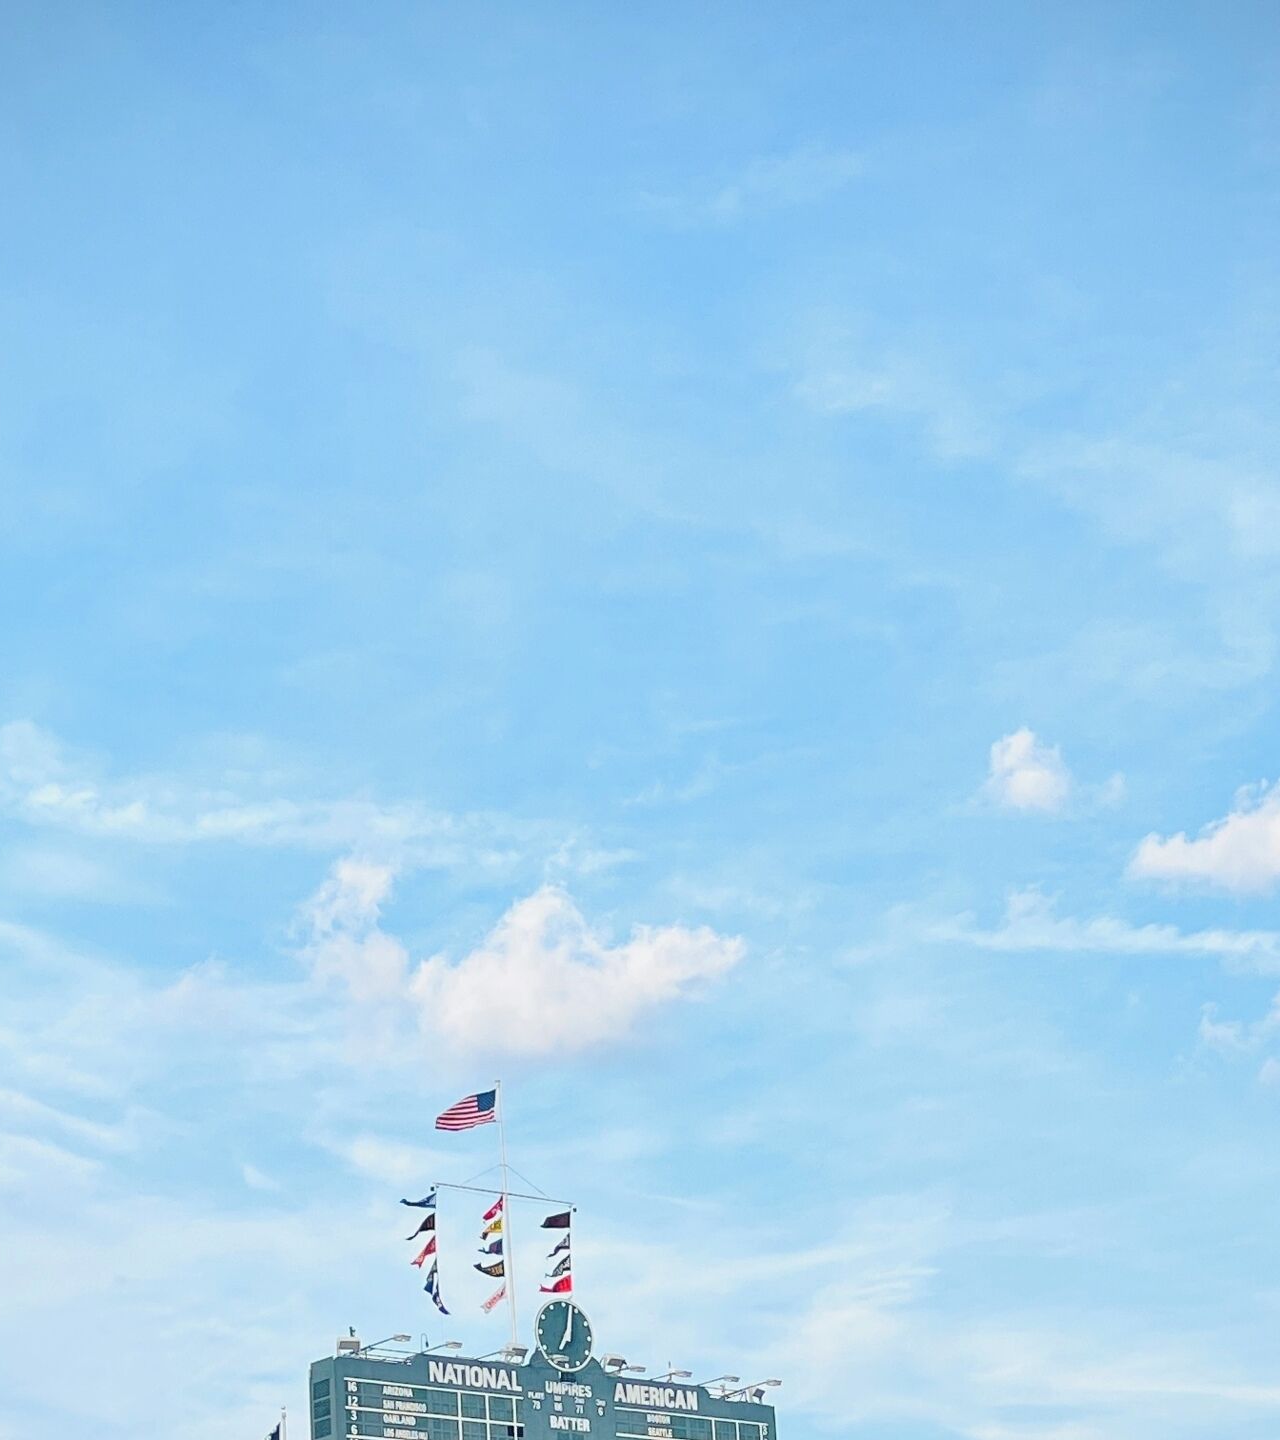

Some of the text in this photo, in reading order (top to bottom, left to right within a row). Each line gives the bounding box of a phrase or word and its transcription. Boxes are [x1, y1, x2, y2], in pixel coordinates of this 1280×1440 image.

[429, 1361, 523, 1391] NATIONAL
[347, 1382, 357, 1392] 16
[545, 1380, 592, 1398] UMPIRES
[348, 1395, 358, 1407] 12
[614, 1383, 698, 1411] AMERICAN
[351, 1410, 357, 1421] 3
[351, 1425, 357, 1434] 6
[550, 1415, 591, 1432] BATTER
